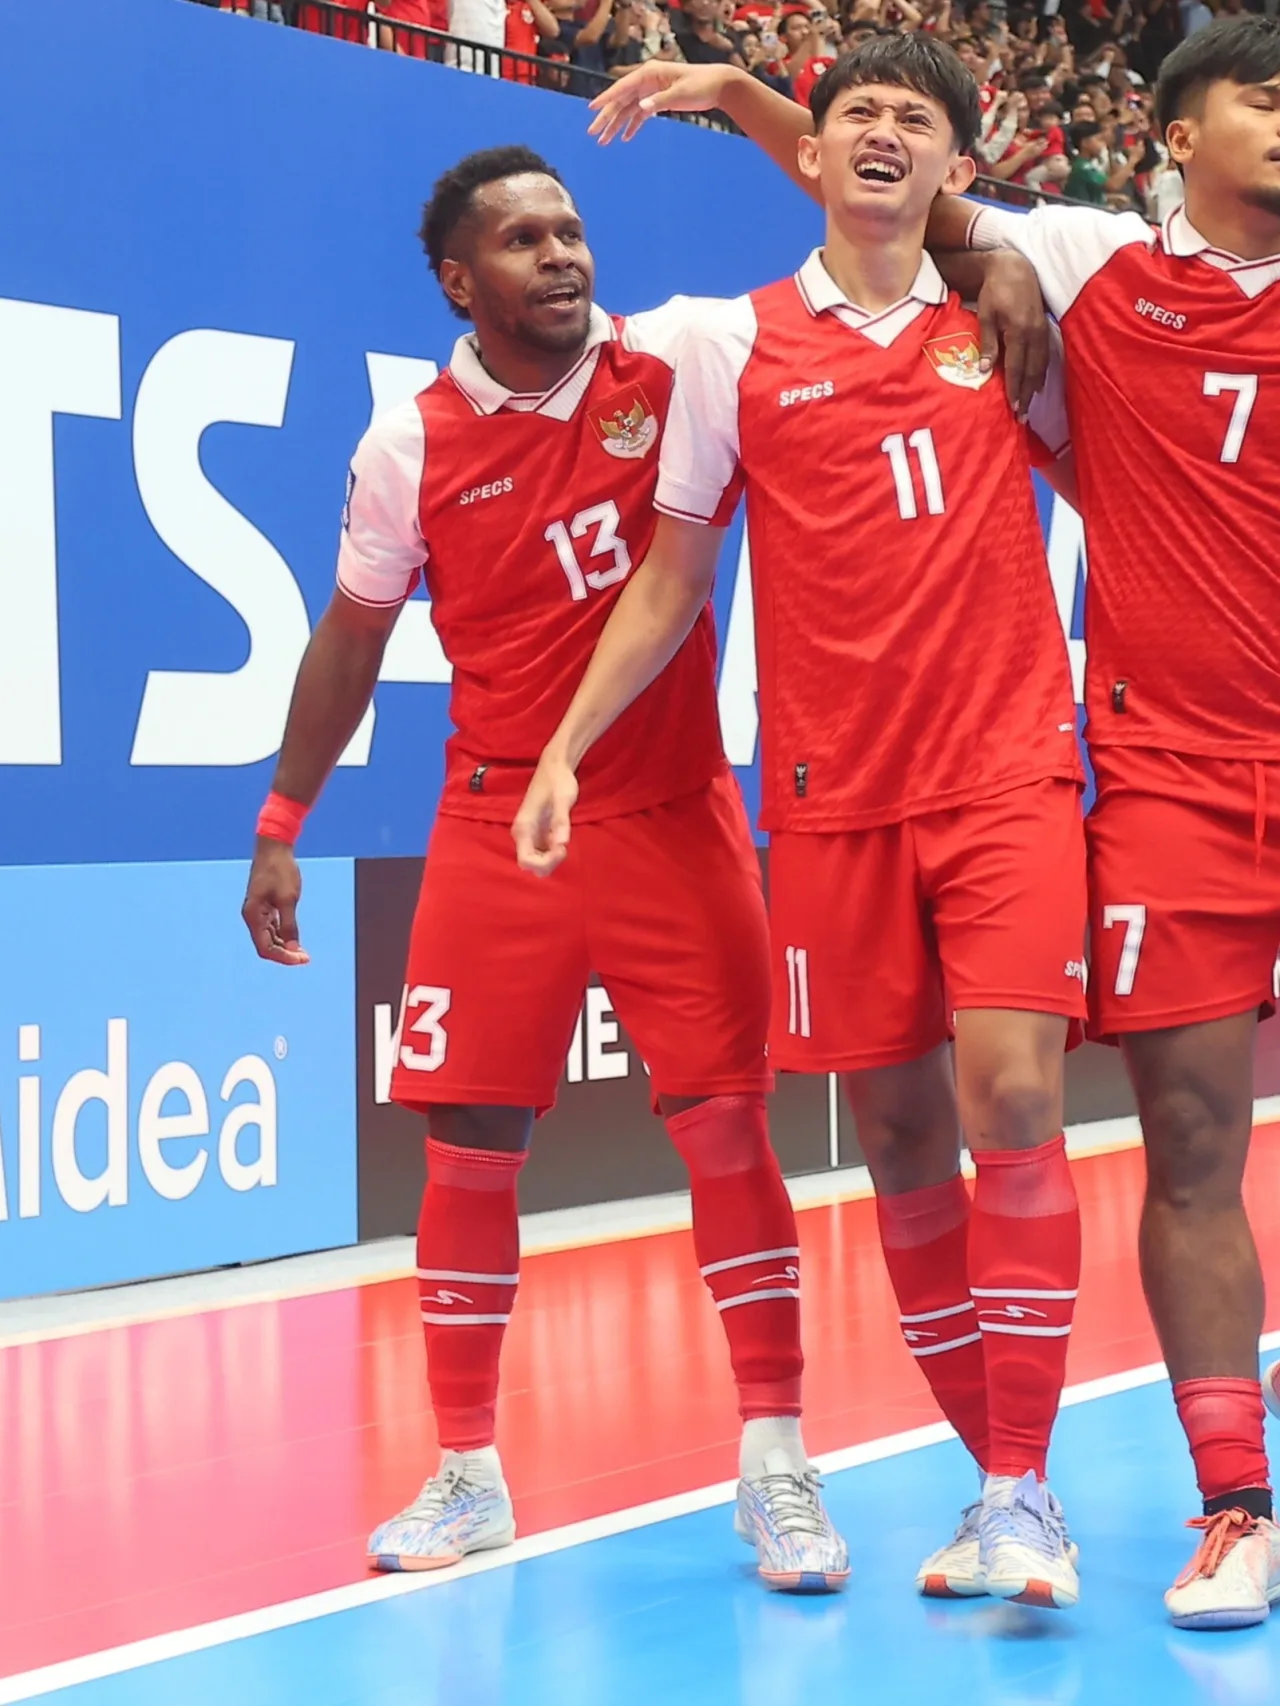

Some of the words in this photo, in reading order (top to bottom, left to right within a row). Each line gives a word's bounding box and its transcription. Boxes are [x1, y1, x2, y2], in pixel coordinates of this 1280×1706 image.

[1134, 297, 1187, 331] SPECS
[779, 379, 834, 407] SPECS
[1202, 372, 1258, 464] 7
[459, 476, 515, 506] SPECS
[881, 428, 945, 520] 11
[544, 500, 634, 602] 13
[785, 945, 811, 1038] 11
[1103, 904, 1146, 995] 7
[0, 1017, 278, 1221] idea
